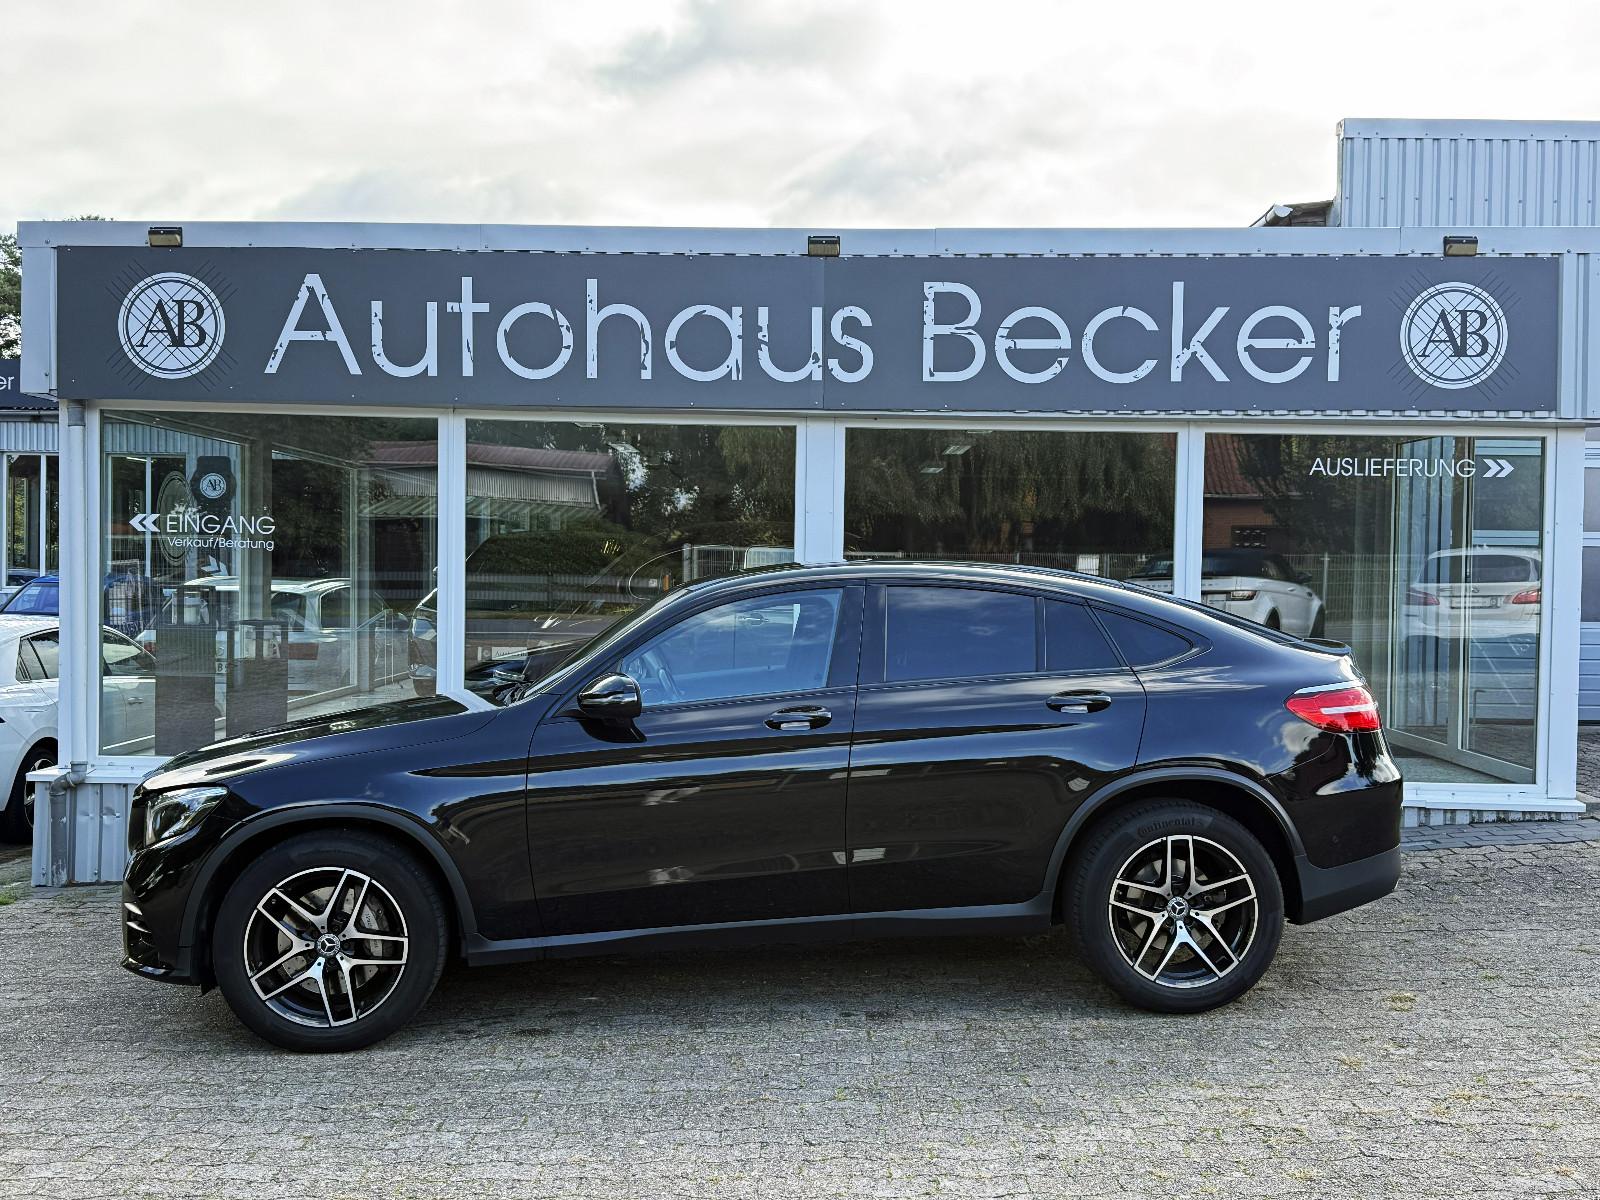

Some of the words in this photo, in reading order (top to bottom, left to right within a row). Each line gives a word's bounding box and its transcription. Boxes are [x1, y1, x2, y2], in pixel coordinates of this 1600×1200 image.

[136, 299, 207, 348] AB
[264, 273, 874, 383] Autohaus
[922, 281, 1362, 384] Becker
[1418, 308, 1489, 358] AB
[1309, 457, 1476, 478] AUSLIEFERUNG
[166, 514, 276, 535] EINGANG
[167, 536, 275, 552] Verkauf/Beratung
